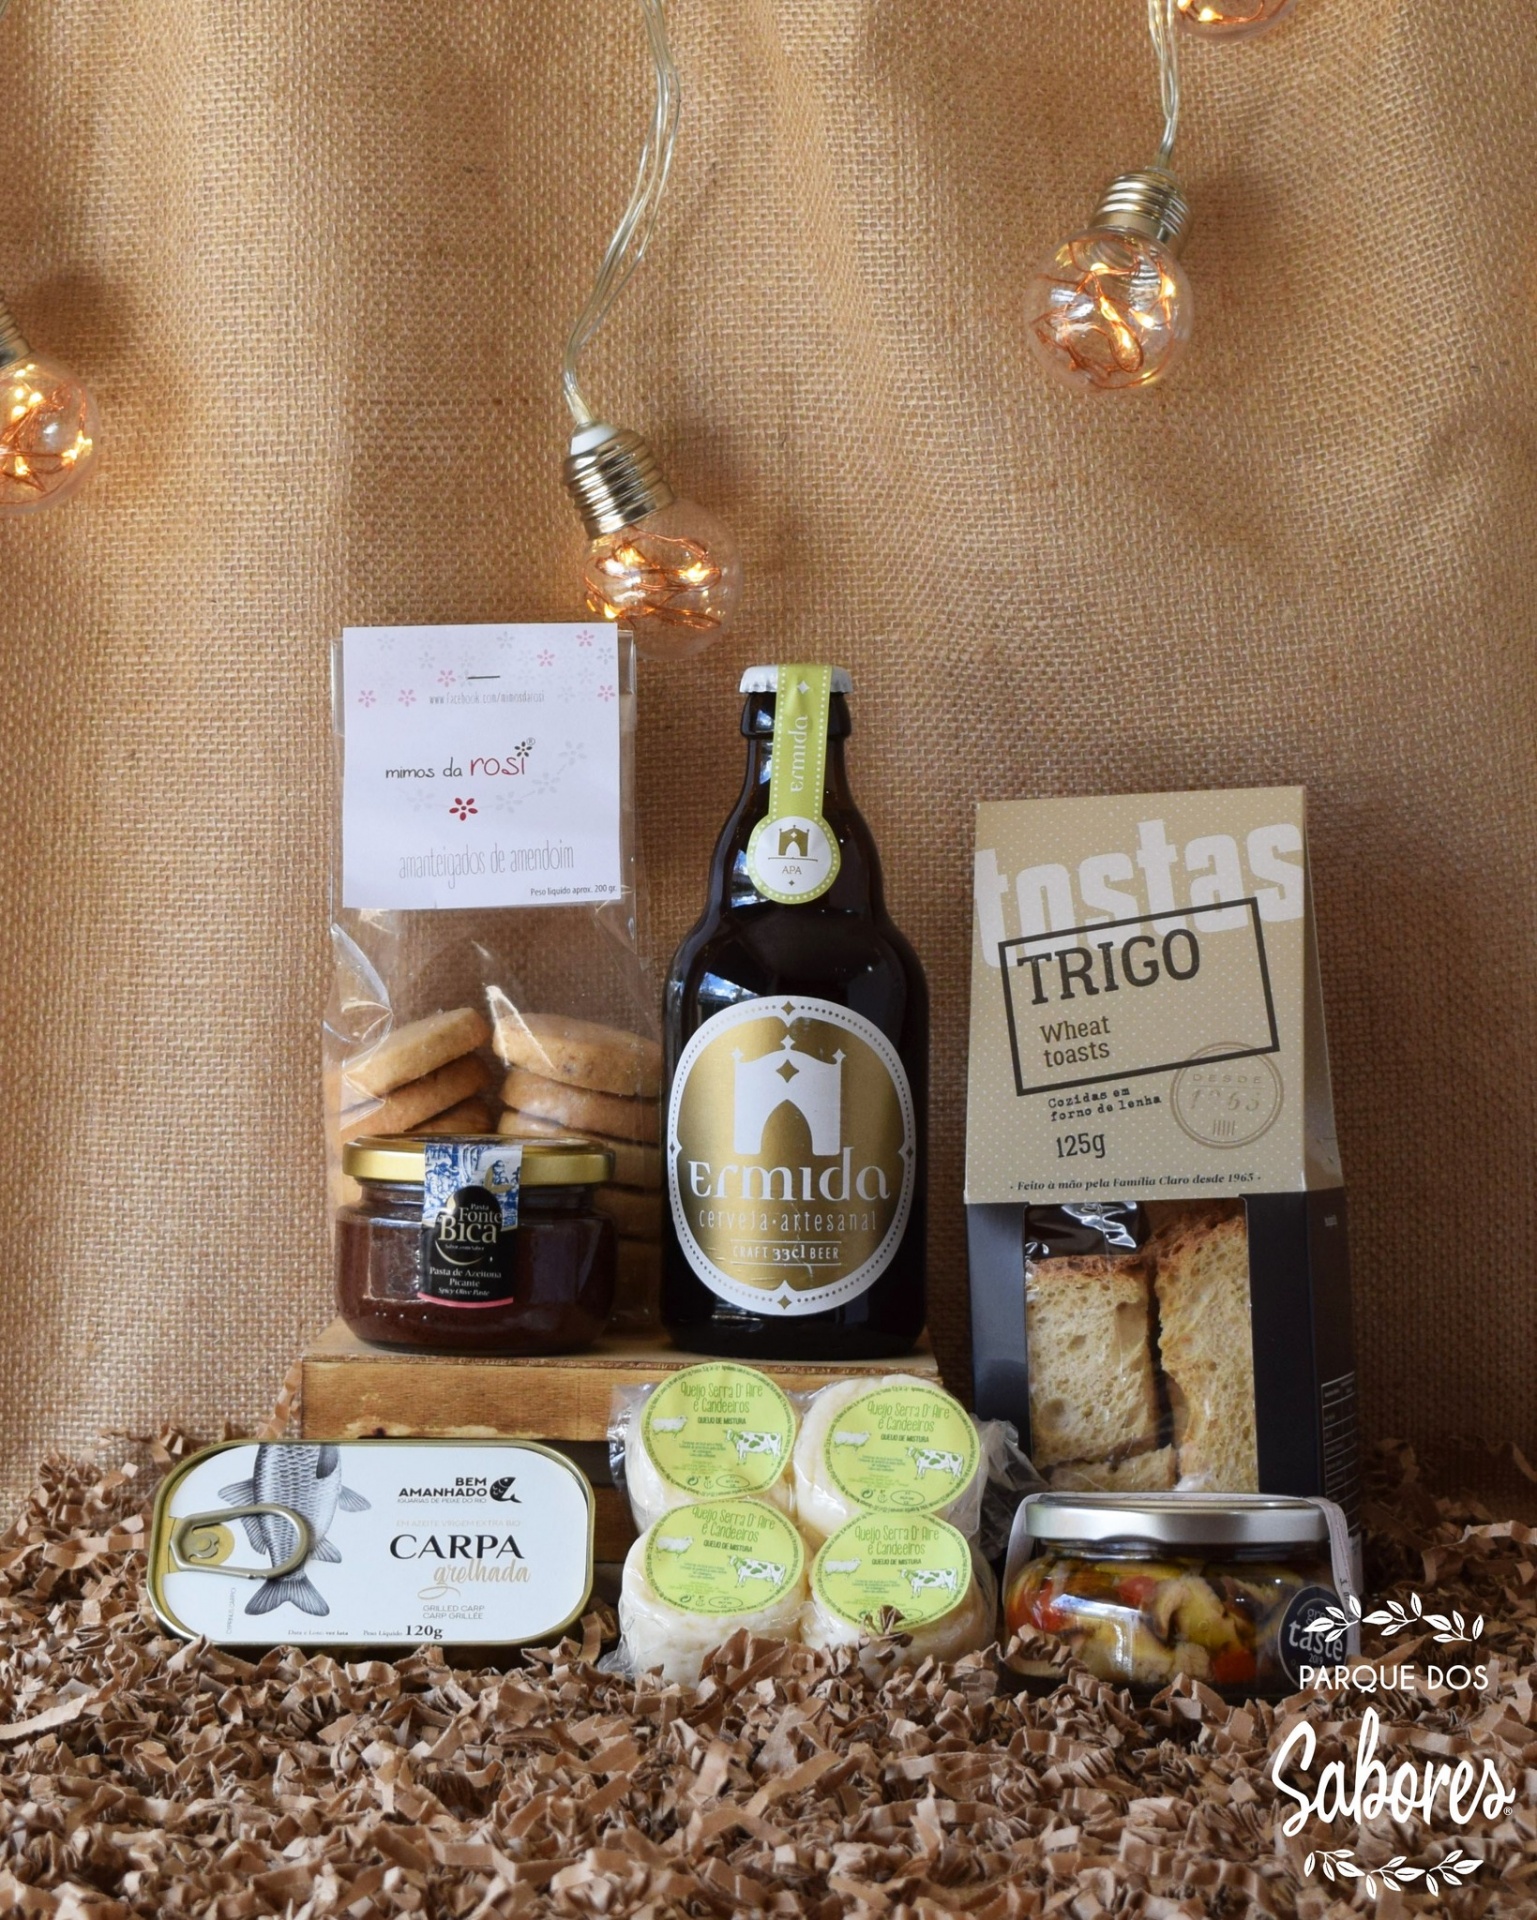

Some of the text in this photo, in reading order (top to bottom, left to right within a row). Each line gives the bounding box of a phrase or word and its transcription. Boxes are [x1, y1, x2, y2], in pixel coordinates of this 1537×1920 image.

[787, 714, 808, 793] Ermida
[385, 755, 525, 778] mimos da rosi
[399, 839, 574, 889] amanteigados de amendoim
[782, 866, 802, 875] APA
[530, 887, 546, 896] Peso
[572, 885, 593, 896] aprox.
[594, 884, 607, 893] 200
[974, 819, 1304, 968] tostas
[1016, 928, 1201, 1005] TRIGO
[1039, 1016, 1111, 1044] Wheat
[1043, 1041, 1111, 1068] toasts
[1193, 1073, 1262, 1084] DESDE
[1048, 1087, 1131, 1109] Cozidas em
[1050, 1095, 1162, 1122] forno de lenha
[1056, 1132, 1106, 1159] 125g
[688, 1147, 891, 1201] Ermida
[1017, 1180, 1045, 1191] Feito
[1058, 1179, 1083, 1190] mão
[1085, 1177, 1110, 1192] pela
[1113, 1176, 1156, 1188] Família
[1158, 1175, 1189, 1186] Claro
[1192, 1173, 1225, 1184] desde
[1228, 1173, 1254, 1183] 1965
[458, 1206, 502, 1224] Fonte
[471, 1203, 489, 1211] Pasta
[438, 1214, 497, 1244] Bica
[732, 1244, 839, 1262] CRAFT 33cl BEER
[429, 1266, 502, 1279] Pasta de Azeitona
[449, 1278, 481, 1288] Picante
[680, 1381, 706, 1401] Queijo
[708, 1383, 734, 1399] Serra
[746, 1382, 763, 1398] Aire
[693, 1399, 750, 1414] e Candeeiros
[867, 1400, 893, 1419] Queijo
[894, 1403, 920, 1418] Serra
[932, 1404, 950, 1420] Aire
[697, 1417, 747, 1425] QUEIJO DE MISTURA
[878, 1417, 935, 1433] e Candeeiros
[898, 1434, 906, 1442] DE
[906, 1434, 930, 1443] MISTURA
[455, 1477, 487, 1487] BEM
[398, 1487, 488, 1497] AMANHADO
[692, 1506, 718, 1523] Queijo
[719, 1509, 746, 1525] Serra
[757, 1514, 776, 1530] Aire
[702, 1522, 759, 1543] e Candeeiros
[854, 1525, 882, 1544] Queijo
[883, 1525, 909, 1541] Serra
[921, 1526, 940, 1541] Aire
[389, 1533, 526, 1560] CARPA
[703, 1539, 753, 1553] QUEIJO DE MISTURA
[868, 1542, 926, 1556] e Candeeiros
[871, 1558, 922, 1566] QUEIJO DE MISTURA
[417, 1558, 532, 1600] grelhada
[448, 1612, 484, 1620] GRILLÉE
[406, 1625, 444, 1640] 120g
[1288, 1620, 1343, 1662] taste
